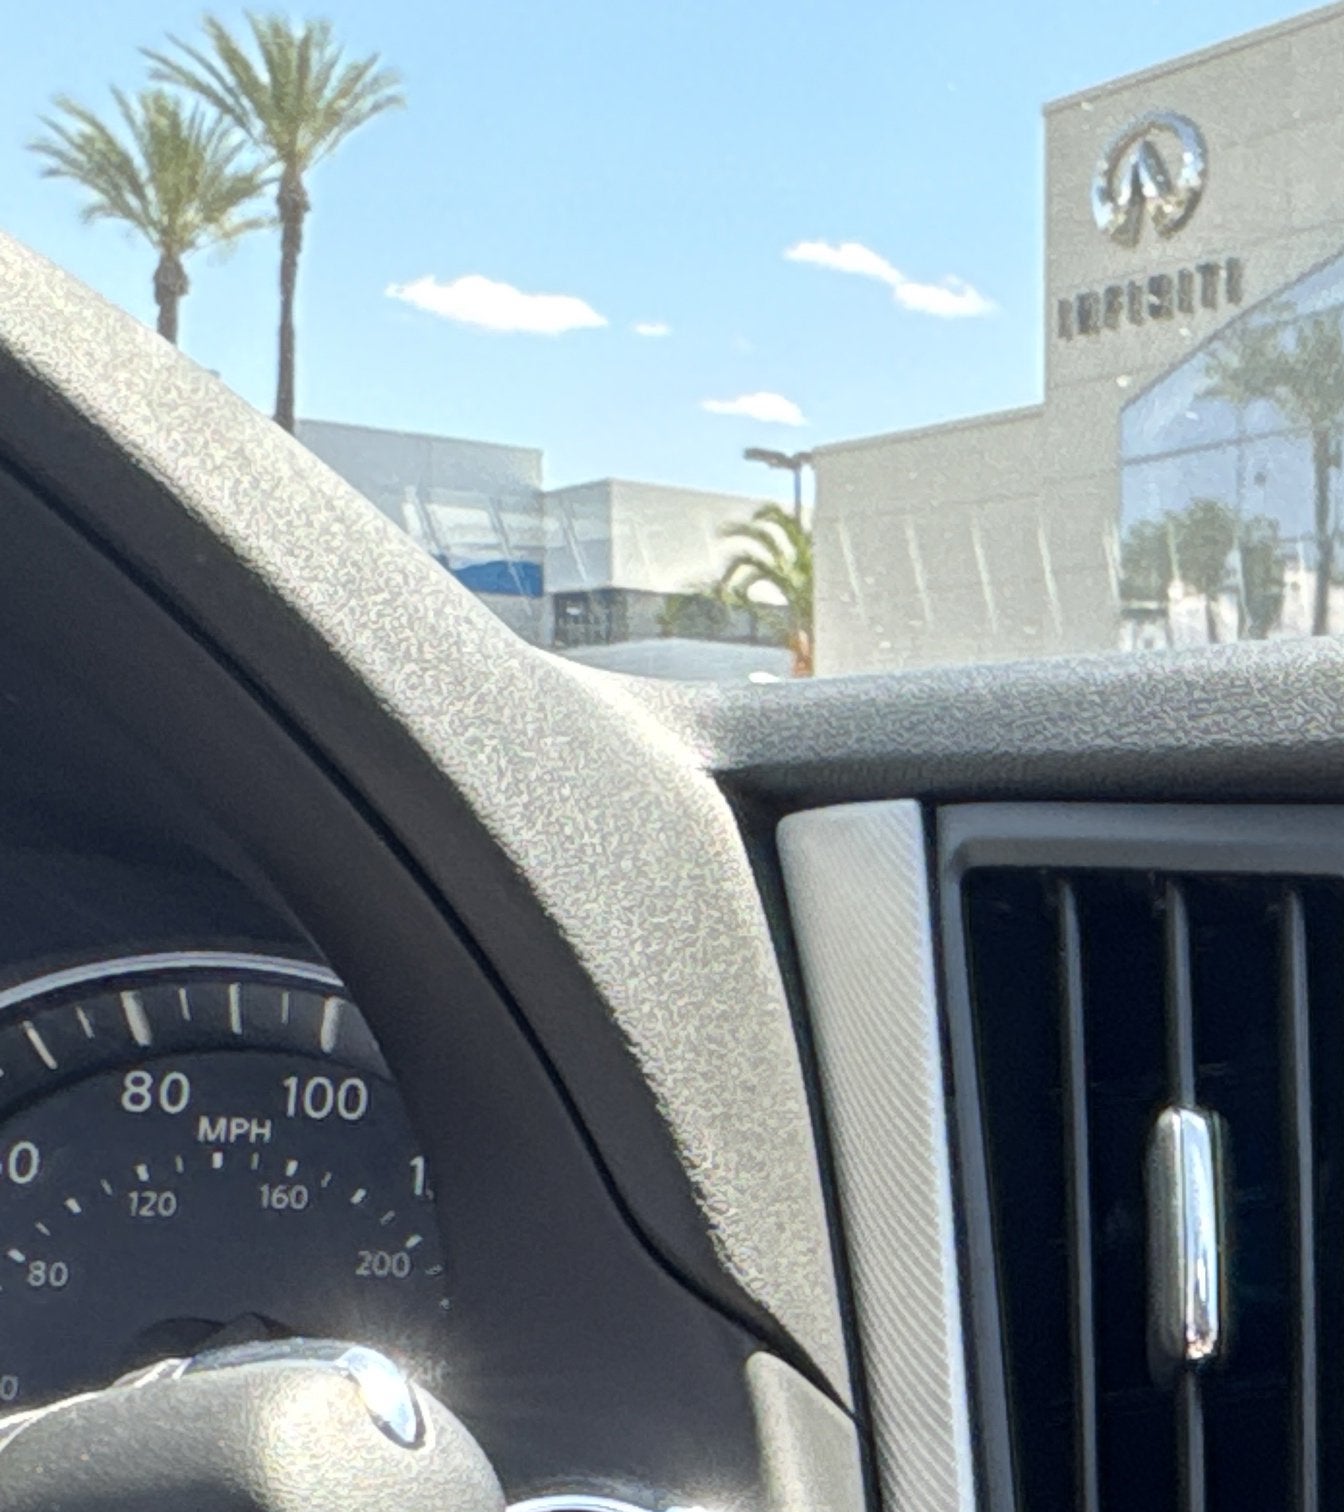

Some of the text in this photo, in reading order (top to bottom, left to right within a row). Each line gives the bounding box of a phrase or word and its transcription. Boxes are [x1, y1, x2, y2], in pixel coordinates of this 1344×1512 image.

[1057, 257, 1245, 341] INFINITI
[120, 1071, 190, 1113] 80
[283, 1076, 368, 1120] 100
[197, 1116, 271, 1143] MPH
[0, 1141, 40, 1184] 0
[128, 1190, 177, 1217] 120
[260, 1184, 308, 1210] 160
[27, 1260, 69, 1287] 80
[355, 1250, 411, 1279] 200
